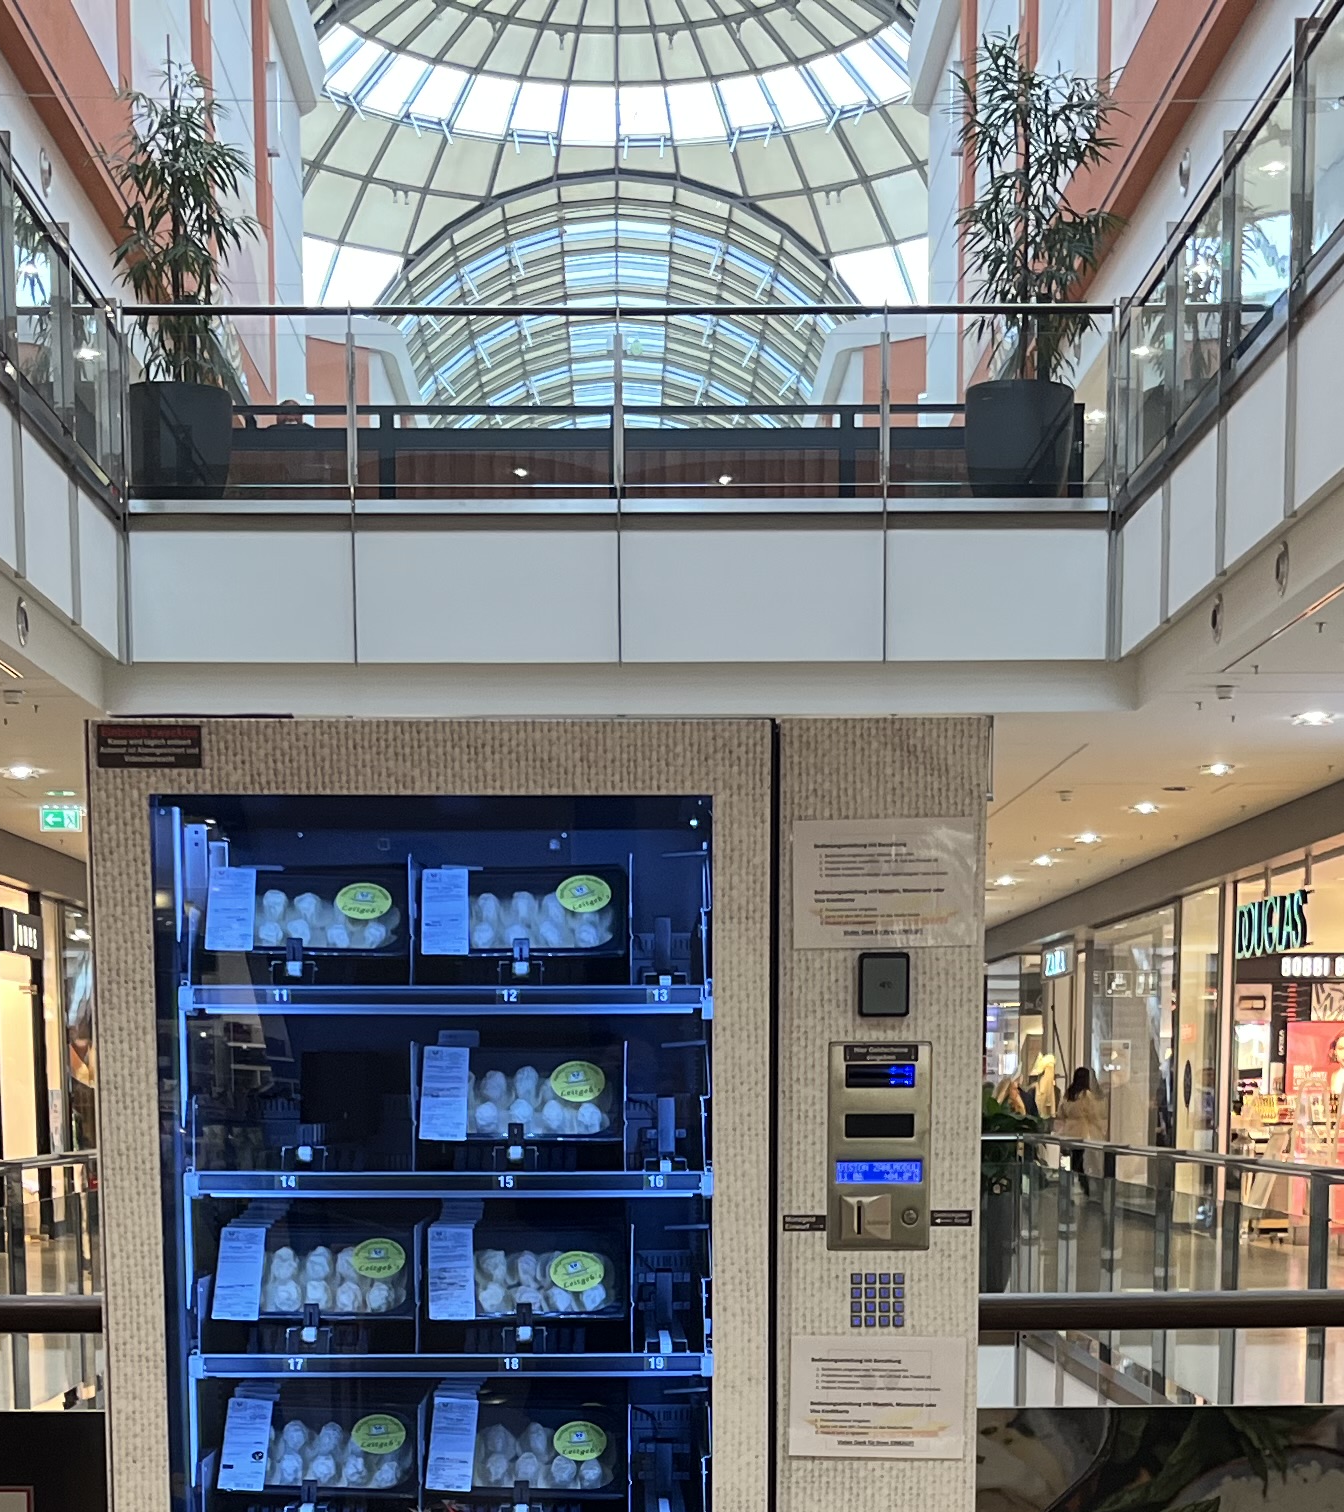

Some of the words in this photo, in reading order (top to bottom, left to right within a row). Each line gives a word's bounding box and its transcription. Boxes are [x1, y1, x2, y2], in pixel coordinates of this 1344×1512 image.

[1235, 888, 1308, 960] DOUGLAS
[1280, 955, 1331, 977] BOBBI
[272, 988, 289, 1002] 11
[501, 988, 518, 1002] 12
[652, 988, 668, 1002] 13
[279, 1175, 296, 1188] 14
[497, 1175, 514, 1188] 15
[648, 1175, 664, 1188] 16
[287, 1358, 304, 1371] 17
[503, 1357, 519, 1370] 18
[648, 1357, 664, 1370] 19
